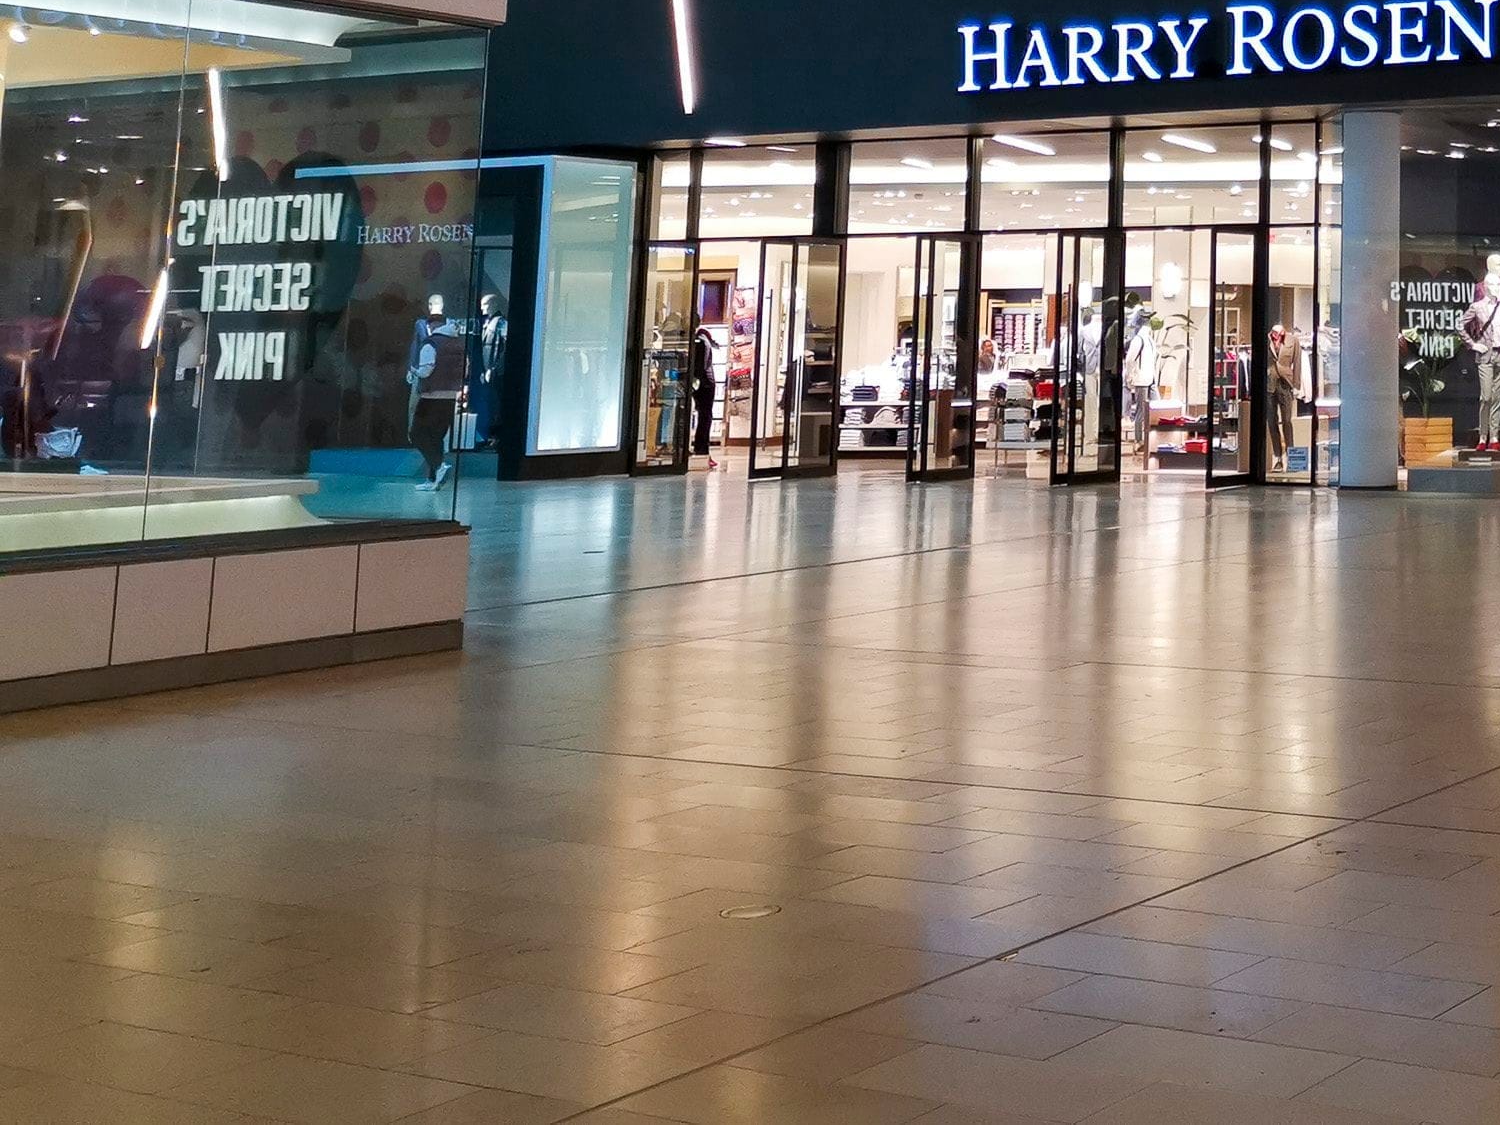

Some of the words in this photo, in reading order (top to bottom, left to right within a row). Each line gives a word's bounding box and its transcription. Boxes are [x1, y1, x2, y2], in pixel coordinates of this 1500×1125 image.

[957, 18, 1208, 92] HARRY
[357, 224, 415, 245] HARRY
[418, 222, 475, 243] ROSEN
